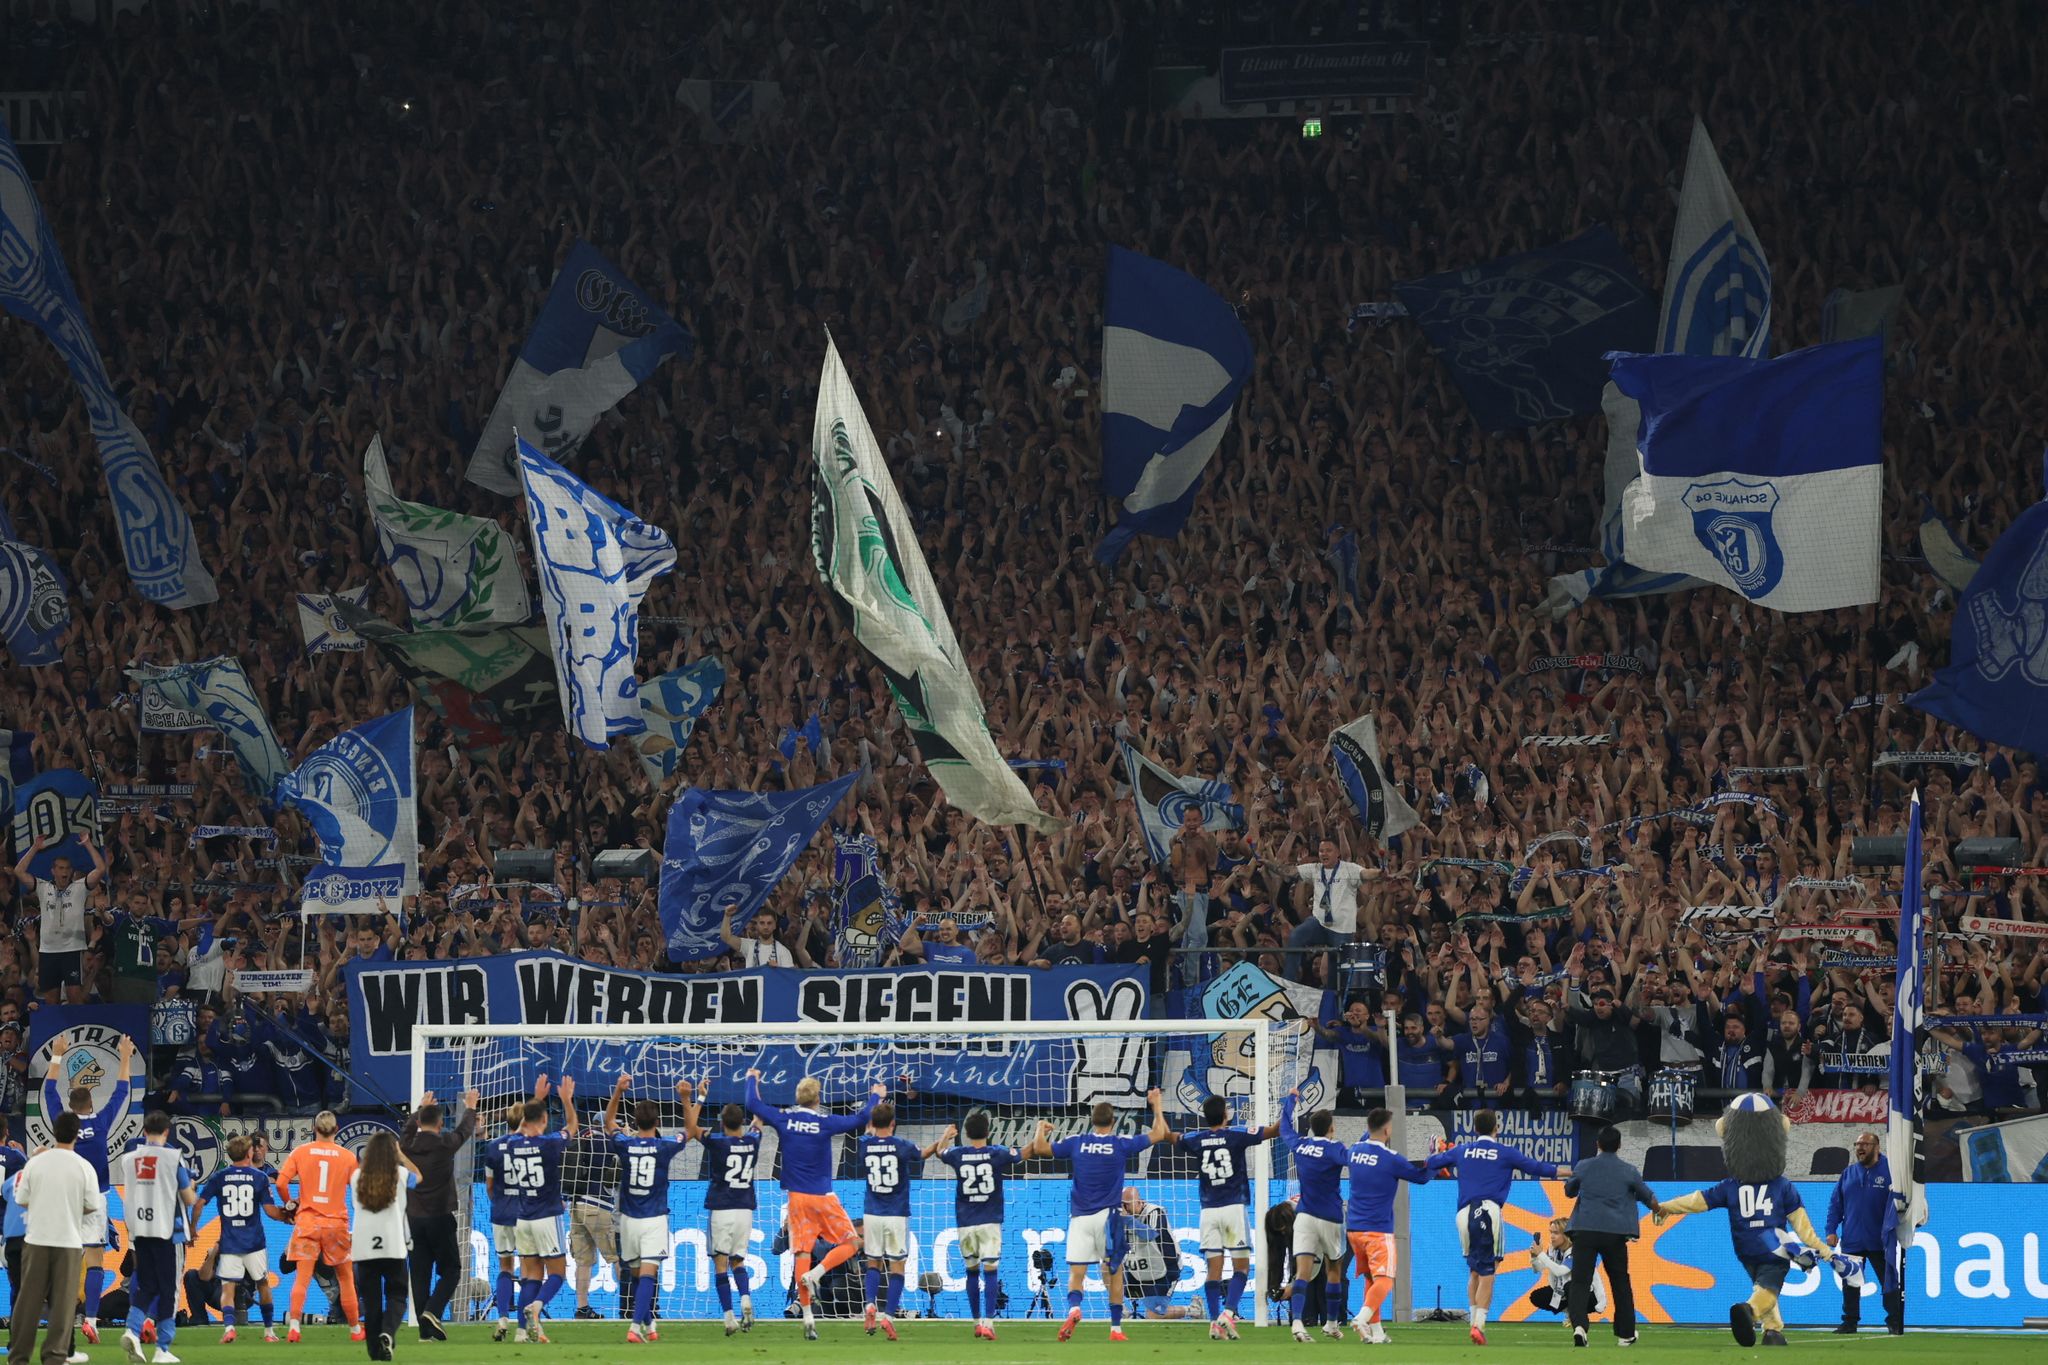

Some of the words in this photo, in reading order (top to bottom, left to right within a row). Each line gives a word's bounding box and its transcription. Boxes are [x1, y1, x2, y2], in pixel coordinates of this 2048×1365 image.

[132, 784, 165, 795] WERDEN
[349, 880, 399, 898] BOYZ
[1801, 928, 1814, 936] FC
[1817, 928, 1860, 938] TWENTE
[240, 973, 303, 981] DURCHHALTEN
[358, 962, 490, 1057] WIR
[514, 957, 764, 1057] WERDEN
[1823, 1053, 1842, 1067] WIR
[787, 1118, 820, 1134] HRS
[1080, 1142, 1114, 1155] HRS
[1296, 1143, 1324, 1158] HRS
[1464, 1148, 1498, 1161] HRS
[1201, 1147, 1235, 1180] 43
[1350, 1151, 1379, 1167] HRS
[318, 1160, 330, 1194] 1
[517, 1156, 546, 1188] 25
[629, 1155, 657, 1187] 19
[724, 1154, 755, 1184] 24
[864, 1154, 900, 1187] 33
[959, 1162, 996, 1195] 23
[222, 1184, 255, 1218] 38
[1738, 1184, 1774, 1219] 04
[137, 1207, 154, 1222] 08
[371, 1236, 384, 1250] 2
